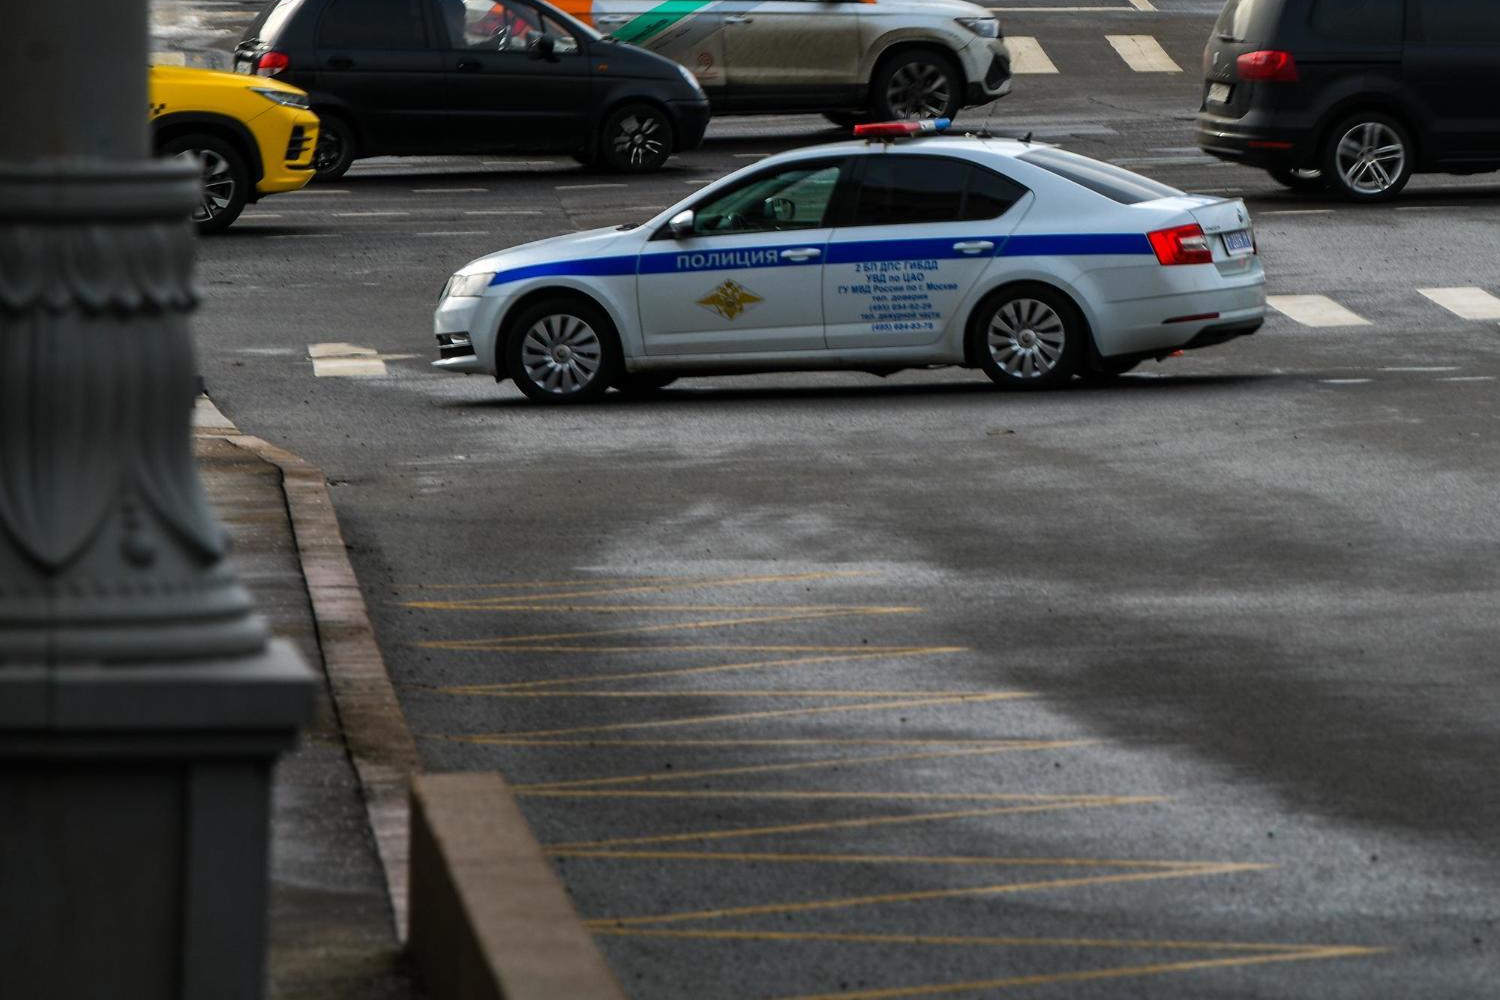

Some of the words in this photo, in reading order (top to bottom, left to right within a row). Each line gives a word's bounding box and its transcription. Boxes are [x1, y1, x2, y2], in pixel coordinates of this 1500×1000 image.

[677, 249, 778, 269] ПОЛИЦИЯ
[855, 264, 862, 272] 2
[863, 262, 878, 272] БП
[880, 261, 901, 272] ДПС
[903, 260, 939, 271] ГИБДД
[866, 274, 887, 283] УВД
[902, 272, 925, 283] ЦАО
[838, 286, 848, 294] ГУ
[850, 285, 872, 294] МВД
[873, 284, 904, 293] России
[926, 282, 958, 291] Москве
